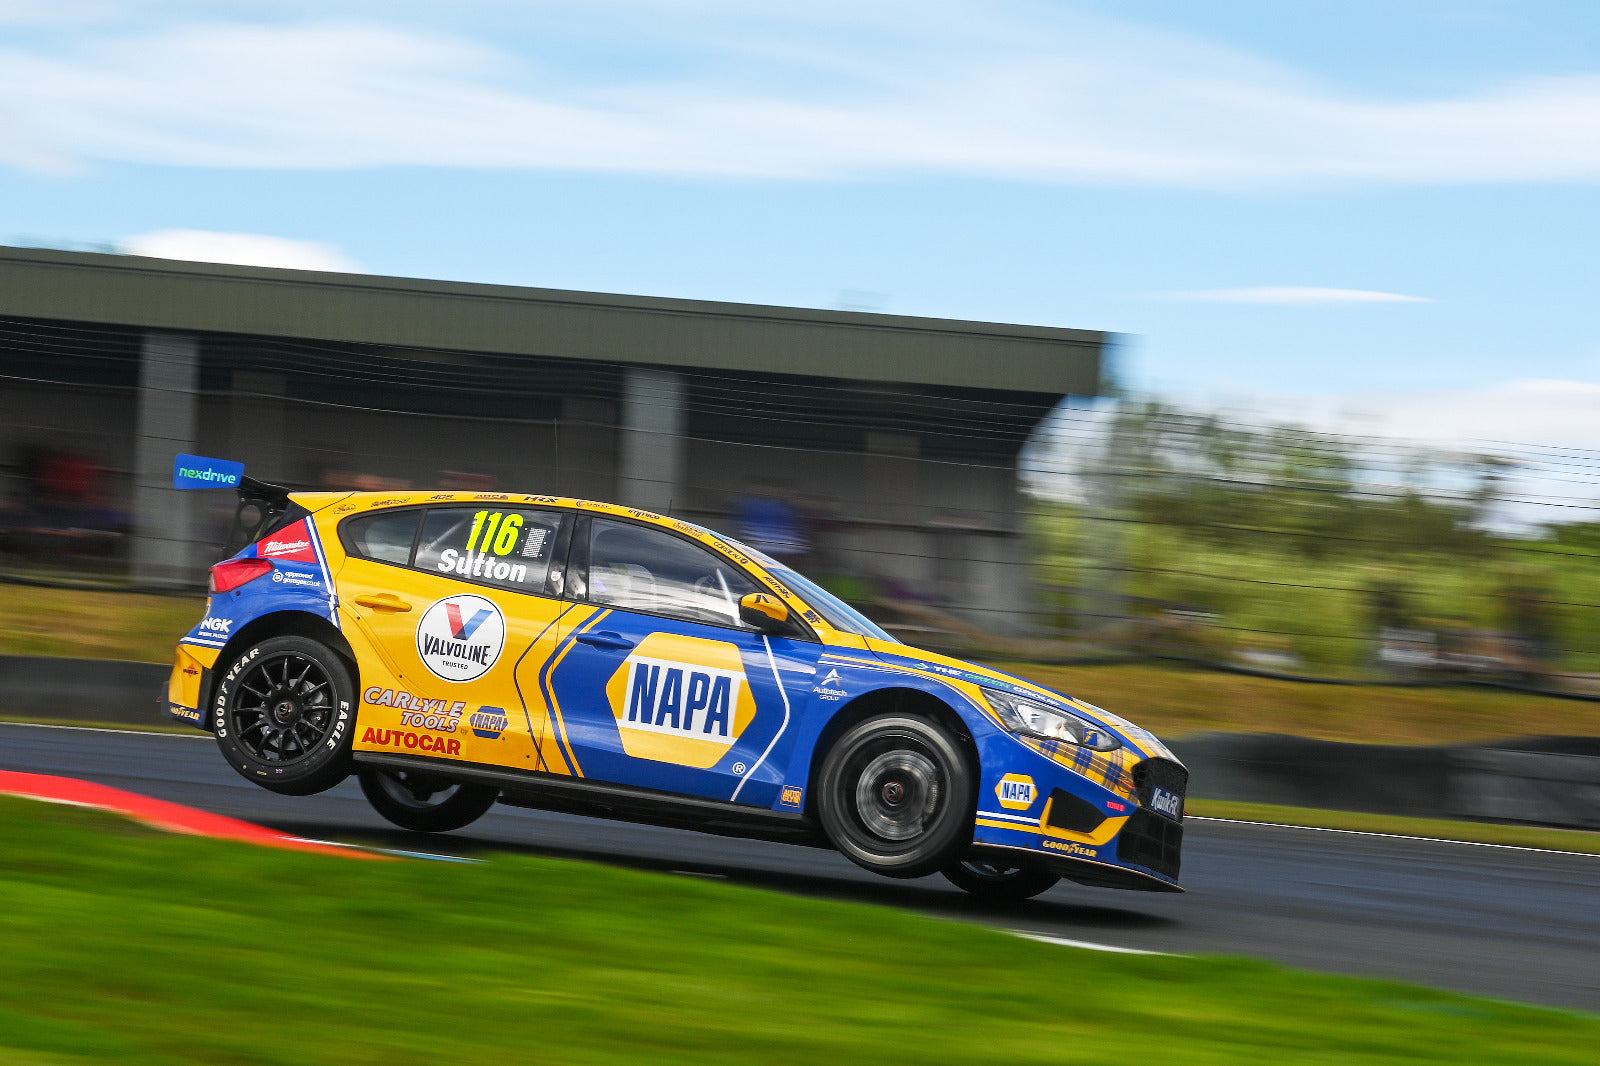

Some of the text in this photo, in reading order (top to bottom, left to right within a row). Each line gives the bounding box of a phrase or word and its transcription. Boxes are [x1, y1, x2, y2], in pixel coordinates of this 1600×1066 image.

[179, 467, 236, 484] nexdrive
[466, 511, 524, 556] 116
[438, 548, 527, 583] Sutton
[200, 617, 233, 633] NGK
[424, 632, 491, 667] VALVOLINE
[442, 660, 469, 670] TRUSTED
[363, 686, 467, 718] CARLYLE
[628, 662, 732, 737] NAPA
[813, 686, 848, 697] Autotech
[326, 700, 350, 750] EAGLE
[400, 711, 460, 733] TOOLS
[474, 713, 503, 731] NAPA
[361, 727, 462, 756] AUTOCAR
[1001, 782, 1031, 802] NAPA
[1042, 839, 1098, 858] GOODYEAR
